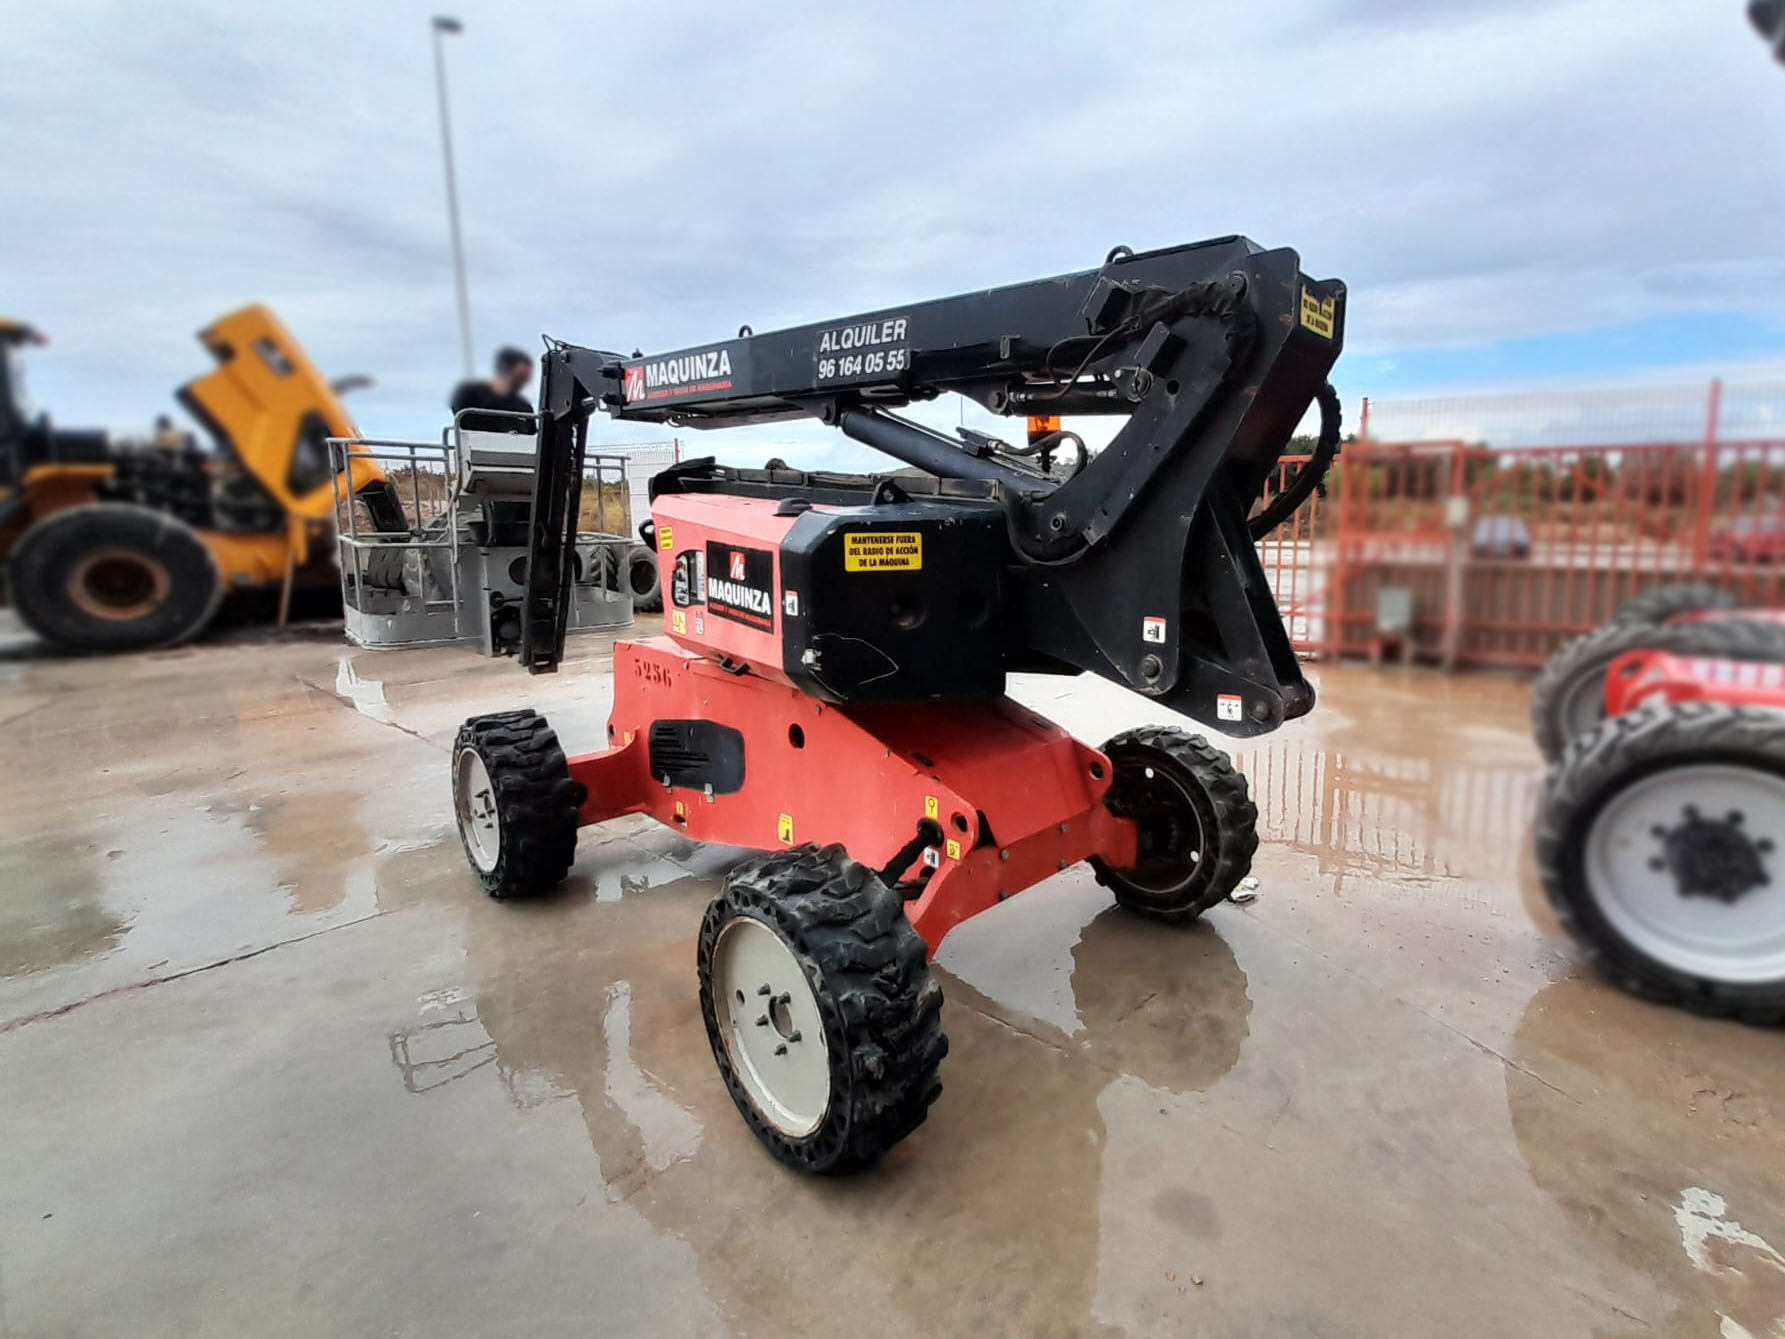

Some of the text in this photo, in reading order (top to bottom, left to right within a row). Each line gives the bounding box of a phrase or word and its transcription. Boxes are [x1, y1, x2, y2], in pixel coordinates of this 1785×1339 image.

[820, 319, 907, 352] ALQUILER
[645, 349, 732, 388] MAQUINZA
[818, 349, 905, 379] 96 164 05 55
[851, 535, 915, 544] MANTENERSE FUERA
[863, 547, 884, 555] RADIO
[886, 546, 893, 555] DE
[858, 558, 867, 567] DE
[869, 558, 877, 567] LA
[708, 577, 772, 616] MAQUINZA
[634, 658, 673, 688] 5256
